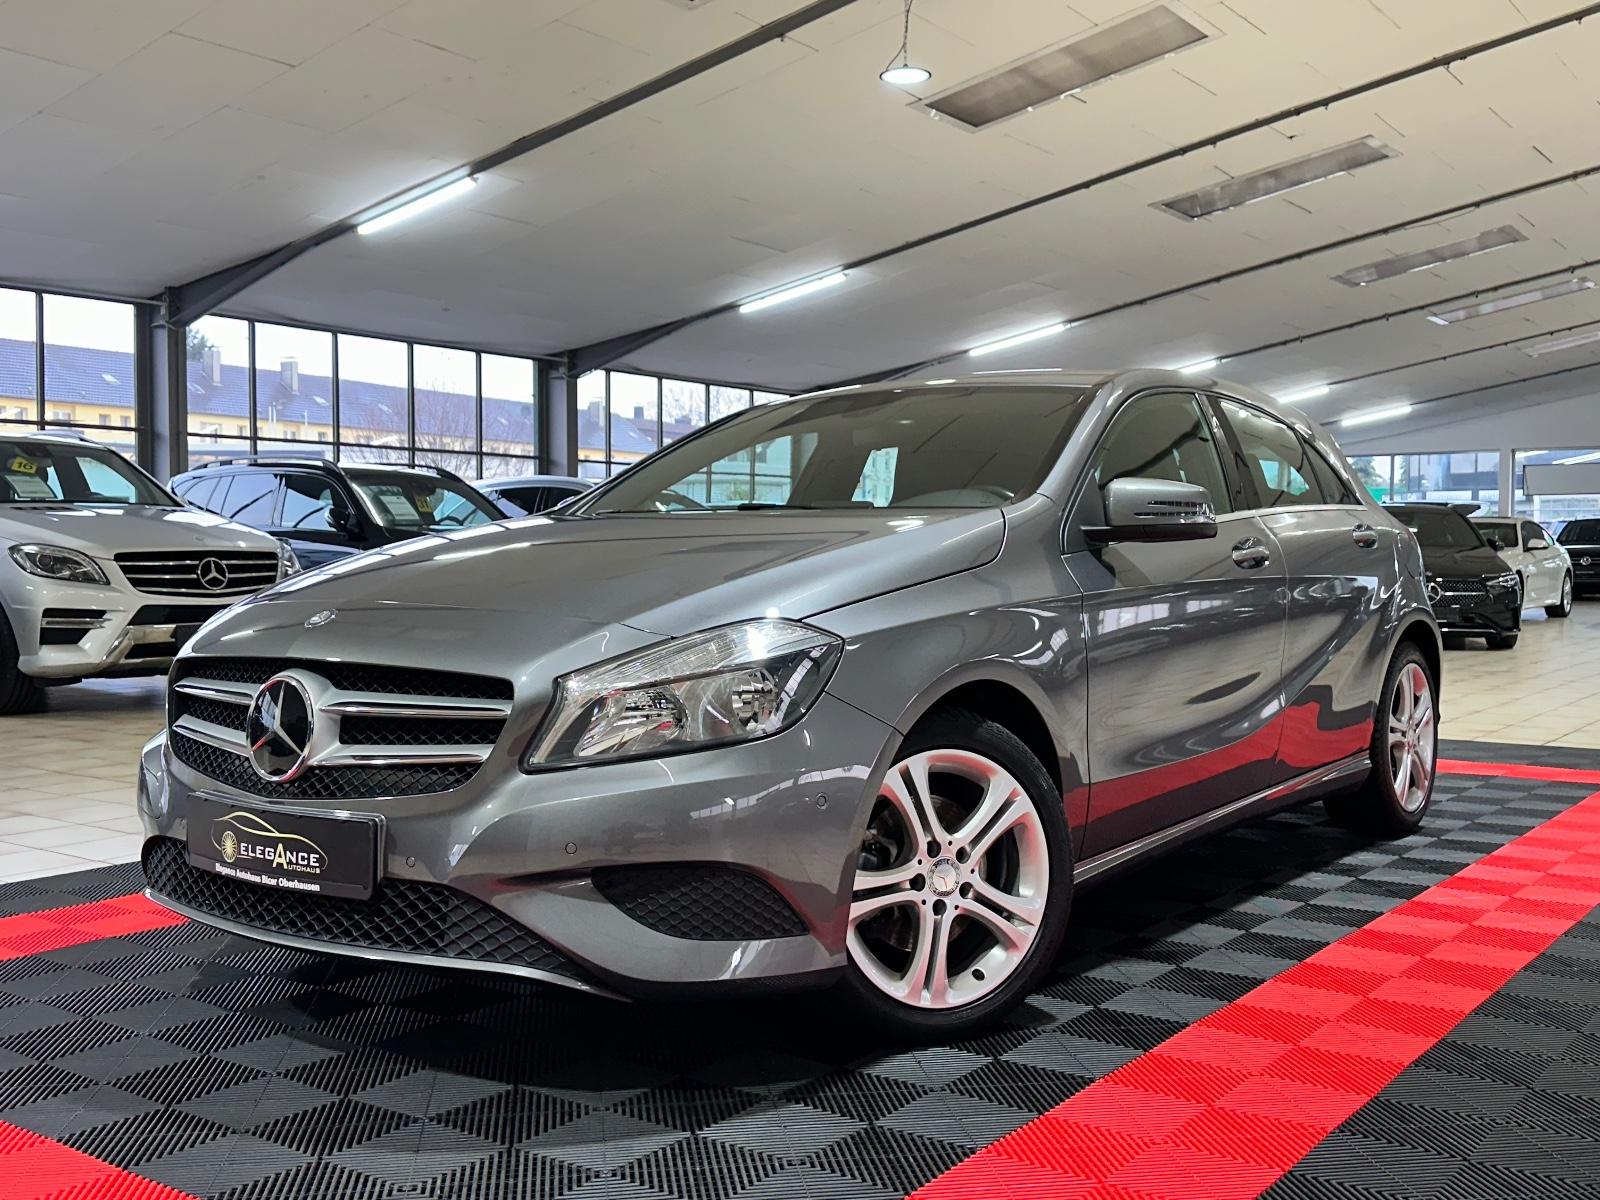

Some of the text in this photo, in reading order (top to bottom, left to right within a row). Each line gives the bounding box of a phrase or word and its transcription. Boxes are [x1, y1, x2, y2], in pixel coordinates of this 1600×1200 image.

[16, 461, 33, 470] 16
[240, 842, 320, 870] ELEGANCE
[215, 863, 320, 891] Elegance Autohaus Bicer Oberhausen
